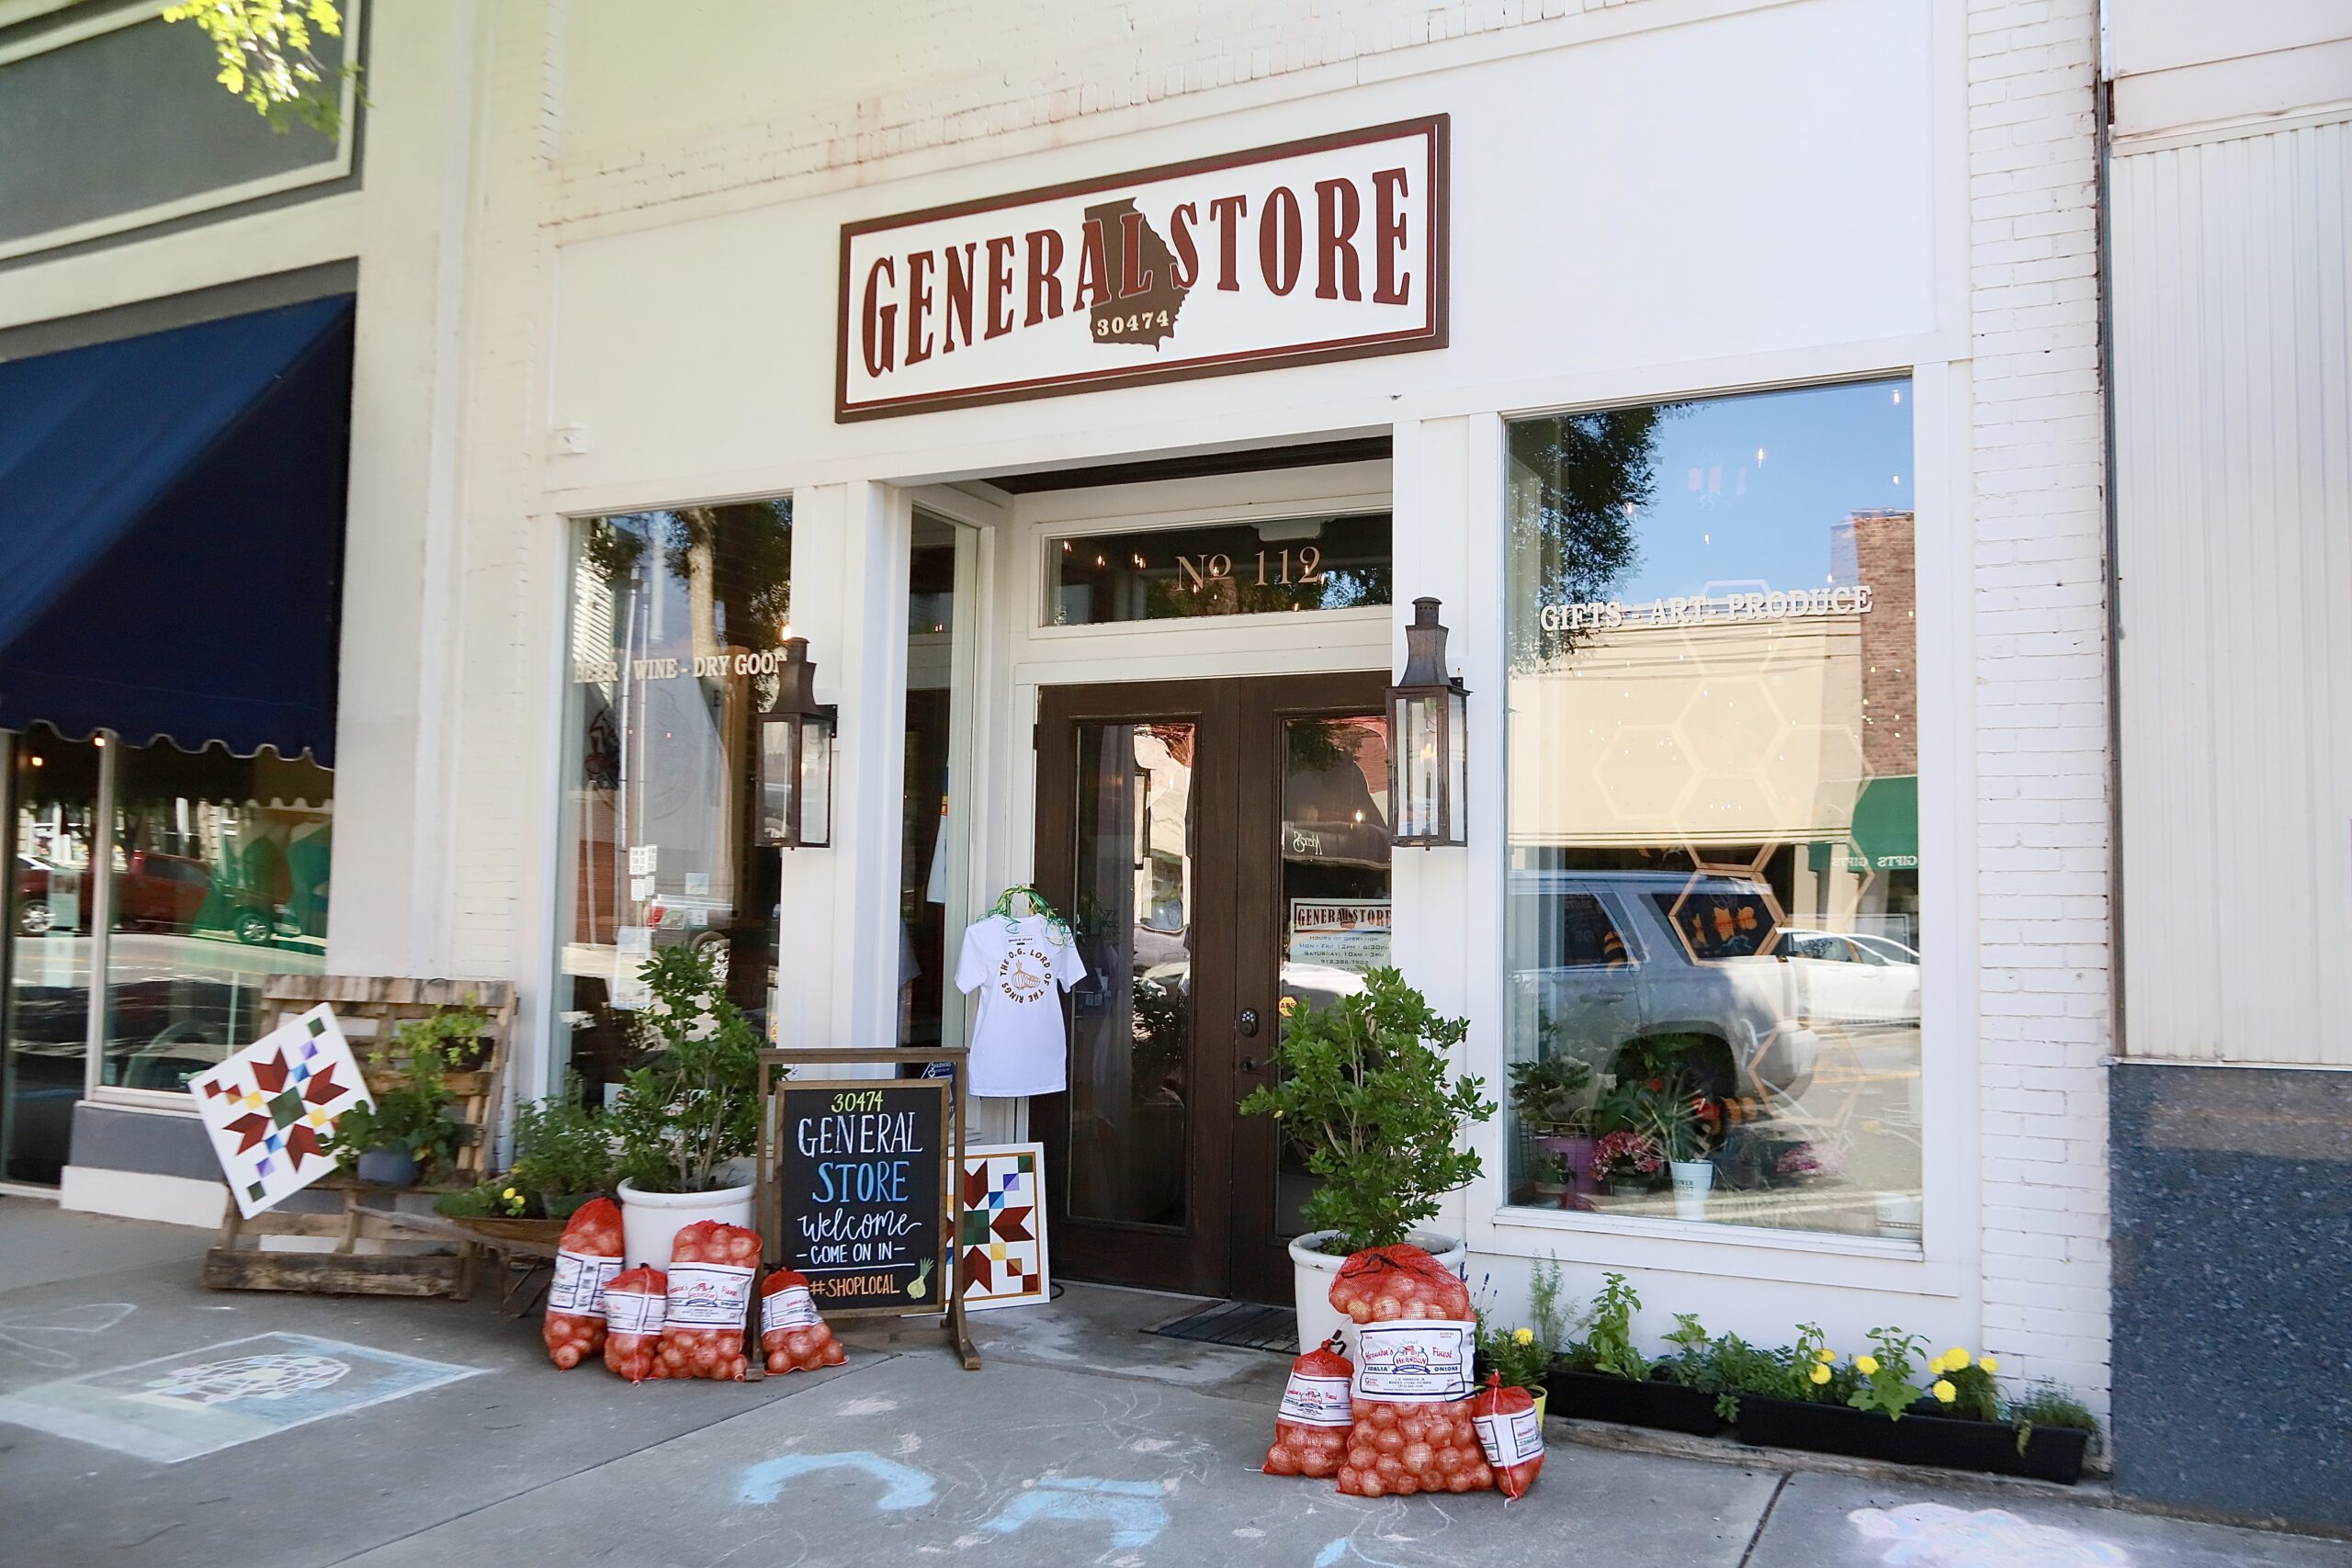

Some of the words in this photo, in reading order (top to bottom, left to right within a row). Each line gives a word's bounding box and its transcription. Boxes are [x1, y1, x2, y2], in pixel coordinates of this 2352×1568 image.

[863, 212, 1152, 378] GENERAL
[1170, 167, 1411, 306] STORE
[1096, 310, 1169, 336] 30474
[1254, 546, 1321, 586] 112
[1540, 601, 1623, 631] GIFTS
[1650, 595, 1706, 625] ART
[1727, 585, 1873, 622] PRODUCE
[633, 658, 678, 681] WINE
[694, 655, 730, 678] DRY
[1297, 908, 1351, 927] GENERAL
[1008, 948, 1025, 959] O.G.
[1030, 949, 1051, 968] LORD
[1000, 959, 1010, 976] THE
[1044, 973, 1052, 987] OF
[1001, 982, 1024, 1003] RINGS
[1028, 989, 1045, 1002] THE
[831, 1090, 884, 1113] 30474
[797, 1111, 923, 1157] GENERAL
[812, 1161, 910, 1202] STORE
[853, 1243, 872, 1262] ON
[809, 1274, 900, 1298] #SHOPLOCAL
